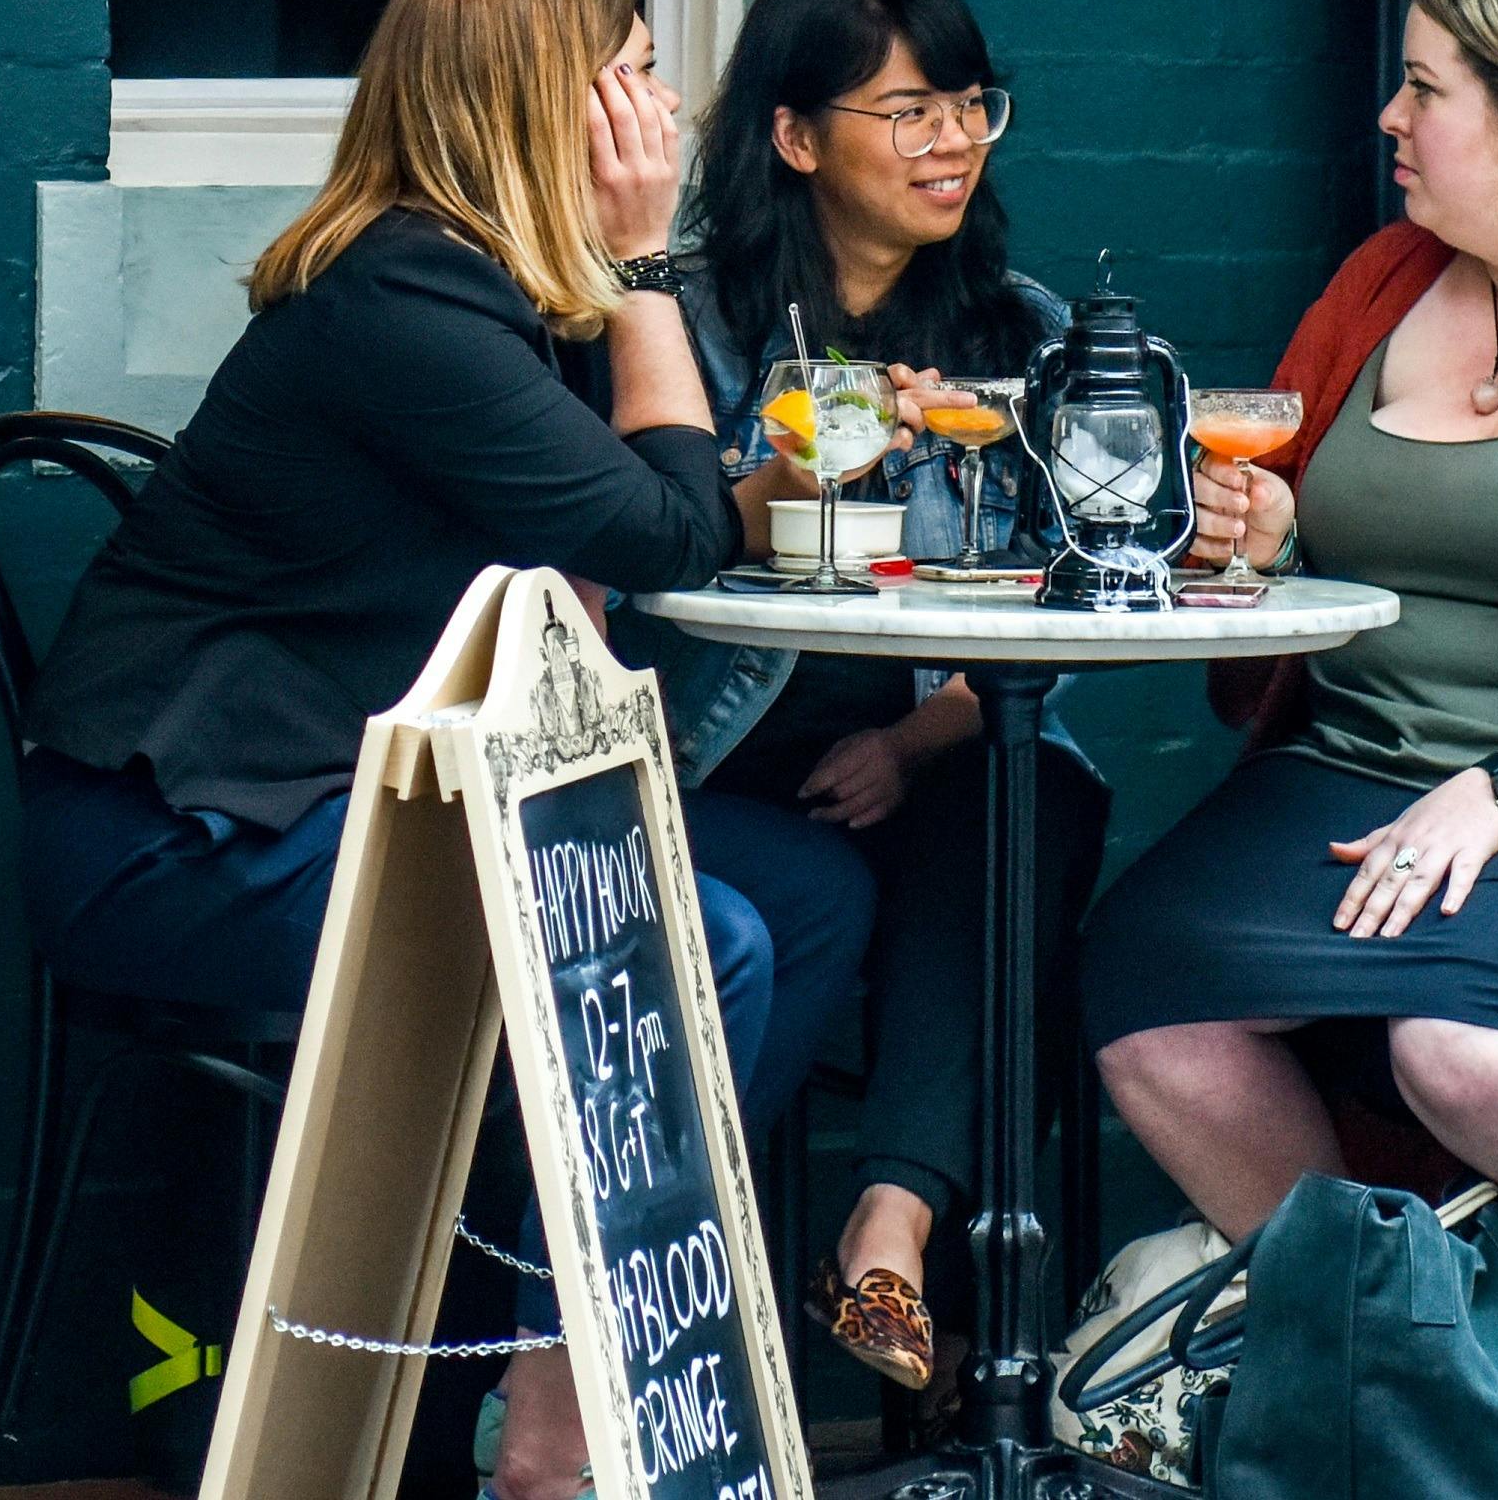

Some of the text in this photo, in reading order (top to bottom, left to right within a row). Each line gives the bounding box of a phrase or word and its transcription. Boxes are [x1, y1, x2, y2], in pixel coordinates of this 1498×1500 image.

[534, 825, 657, 963] HAPPY HOUR
[629, 1220, 731, 1366] BLOOD
[633, 1353, 738, 1484] ORANGE
